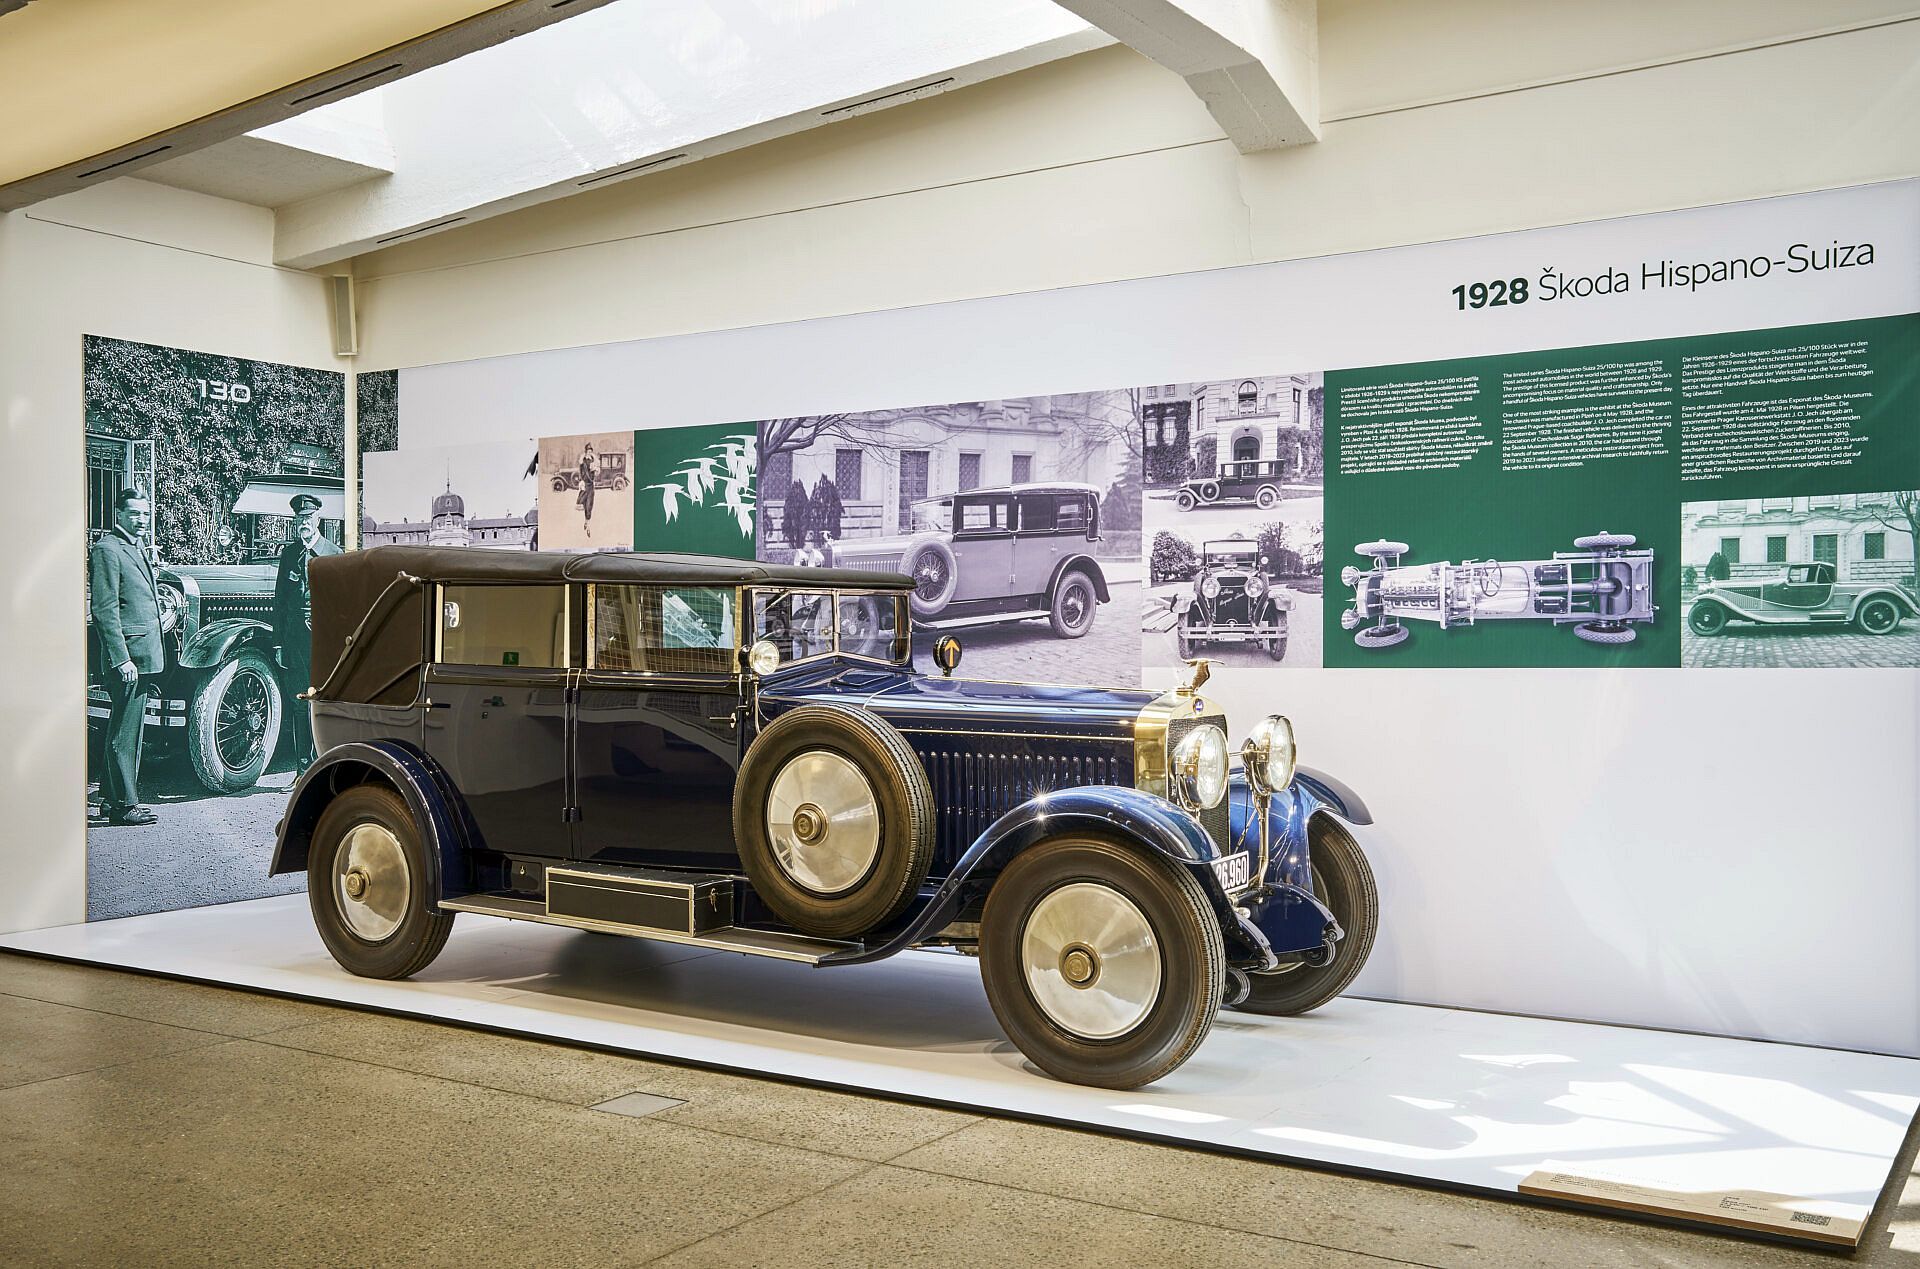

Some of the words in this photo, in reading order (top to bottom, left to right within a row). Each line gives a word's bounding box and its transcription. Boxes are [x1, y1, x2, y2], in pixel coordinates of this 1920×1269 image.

[1452, 277, 1528, 310] 1928
[1538, 266, 1630, 301] Škoda
[1641, 240, 1875, 292] Hispano-Suiza
[196, 379, 251, 403] 130
